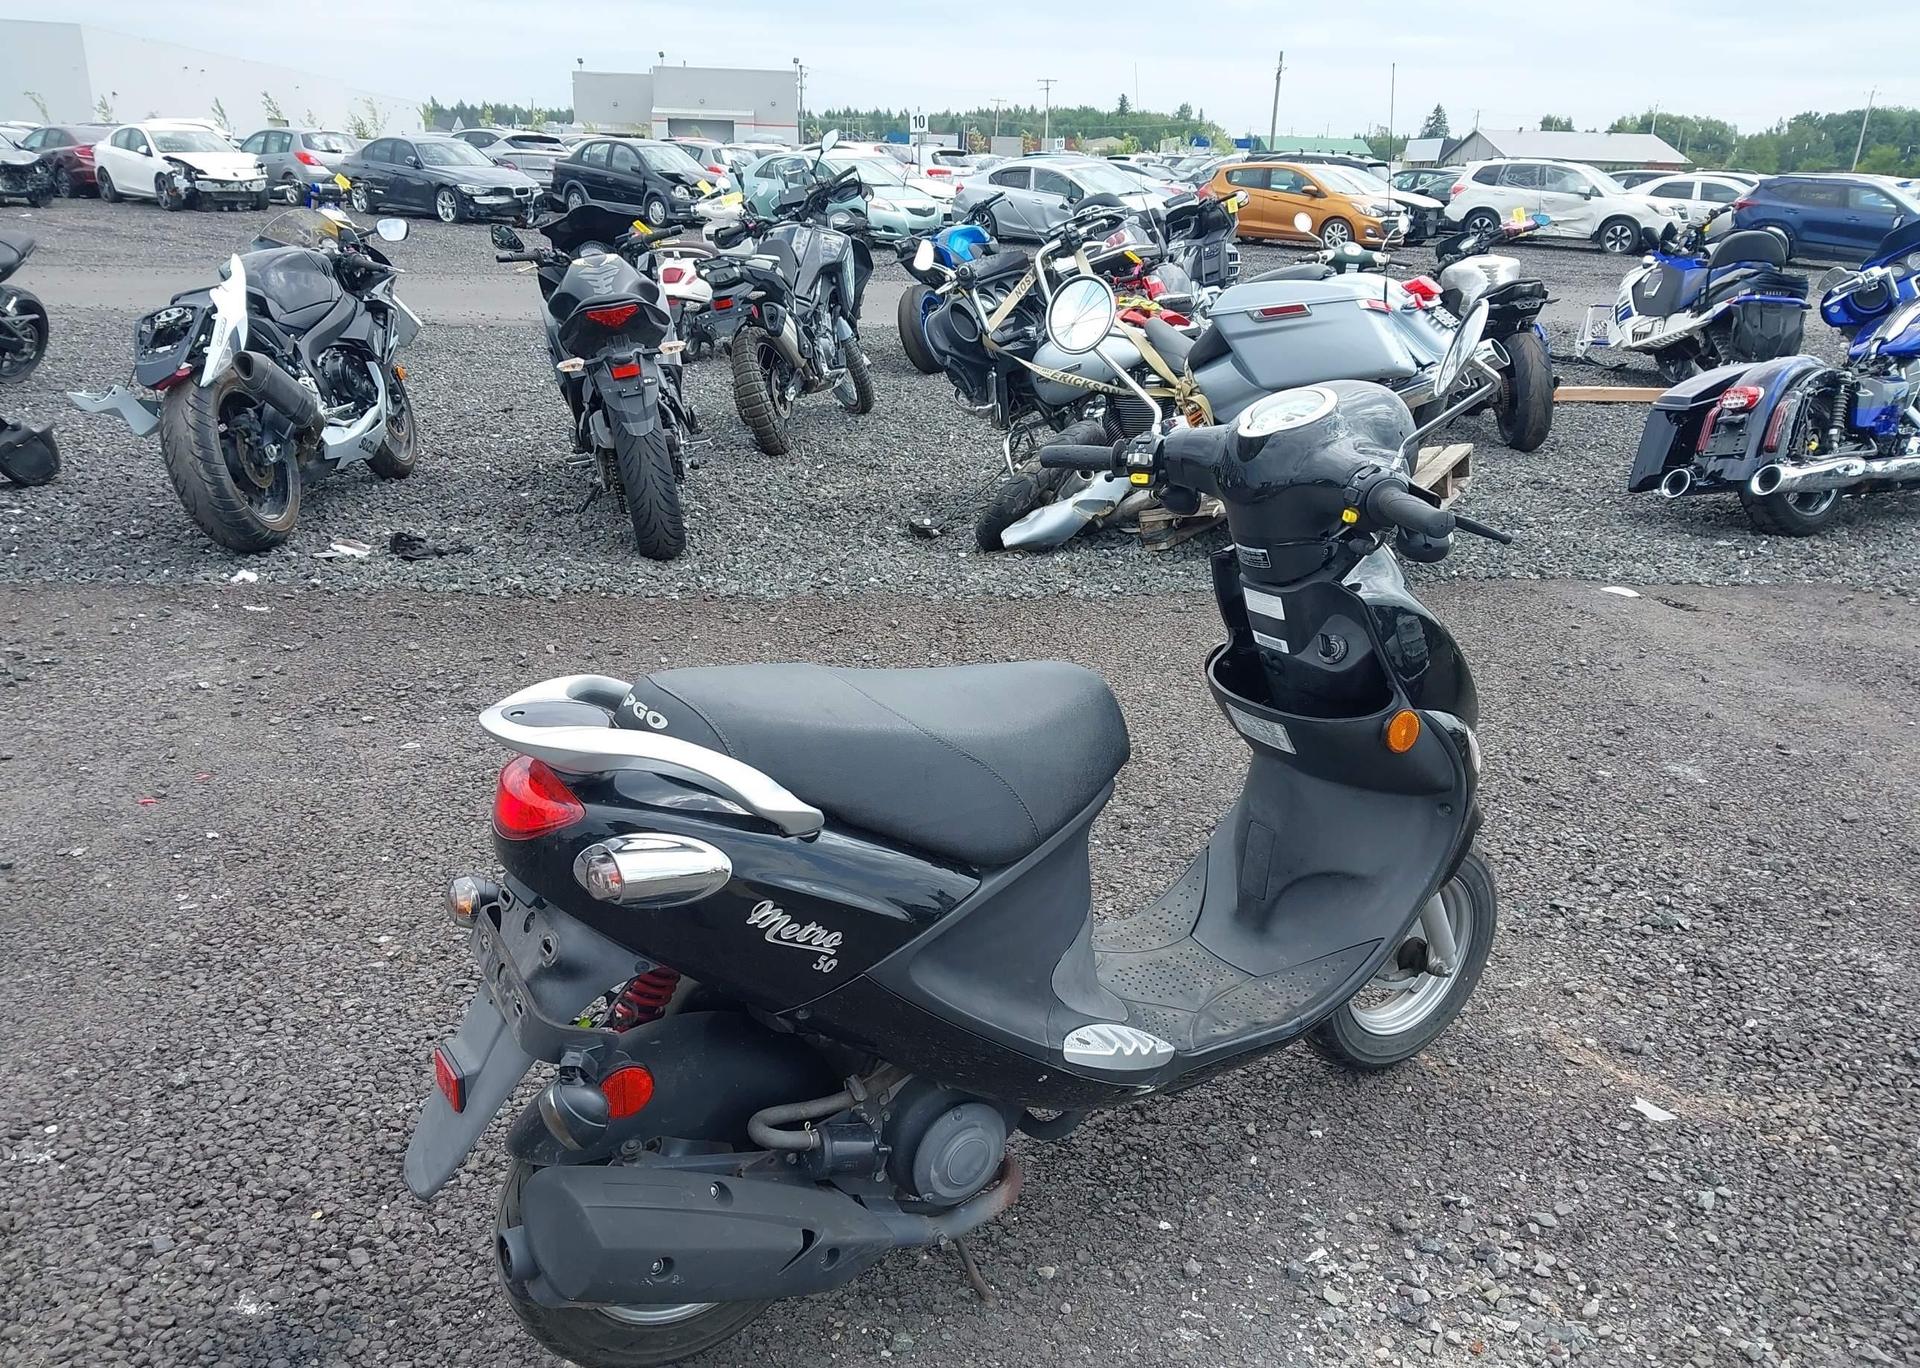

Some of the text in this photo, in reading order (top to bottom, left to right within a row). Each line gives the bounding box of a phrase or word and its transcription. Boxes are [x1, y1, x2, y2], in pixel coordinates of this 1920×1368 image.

[912, 114, 926, 129] 10
[1050, 370, 1121, 395] ERICKSON
[746, 899, 843, 955] Metro
[812, 954, 838, 973] 50
